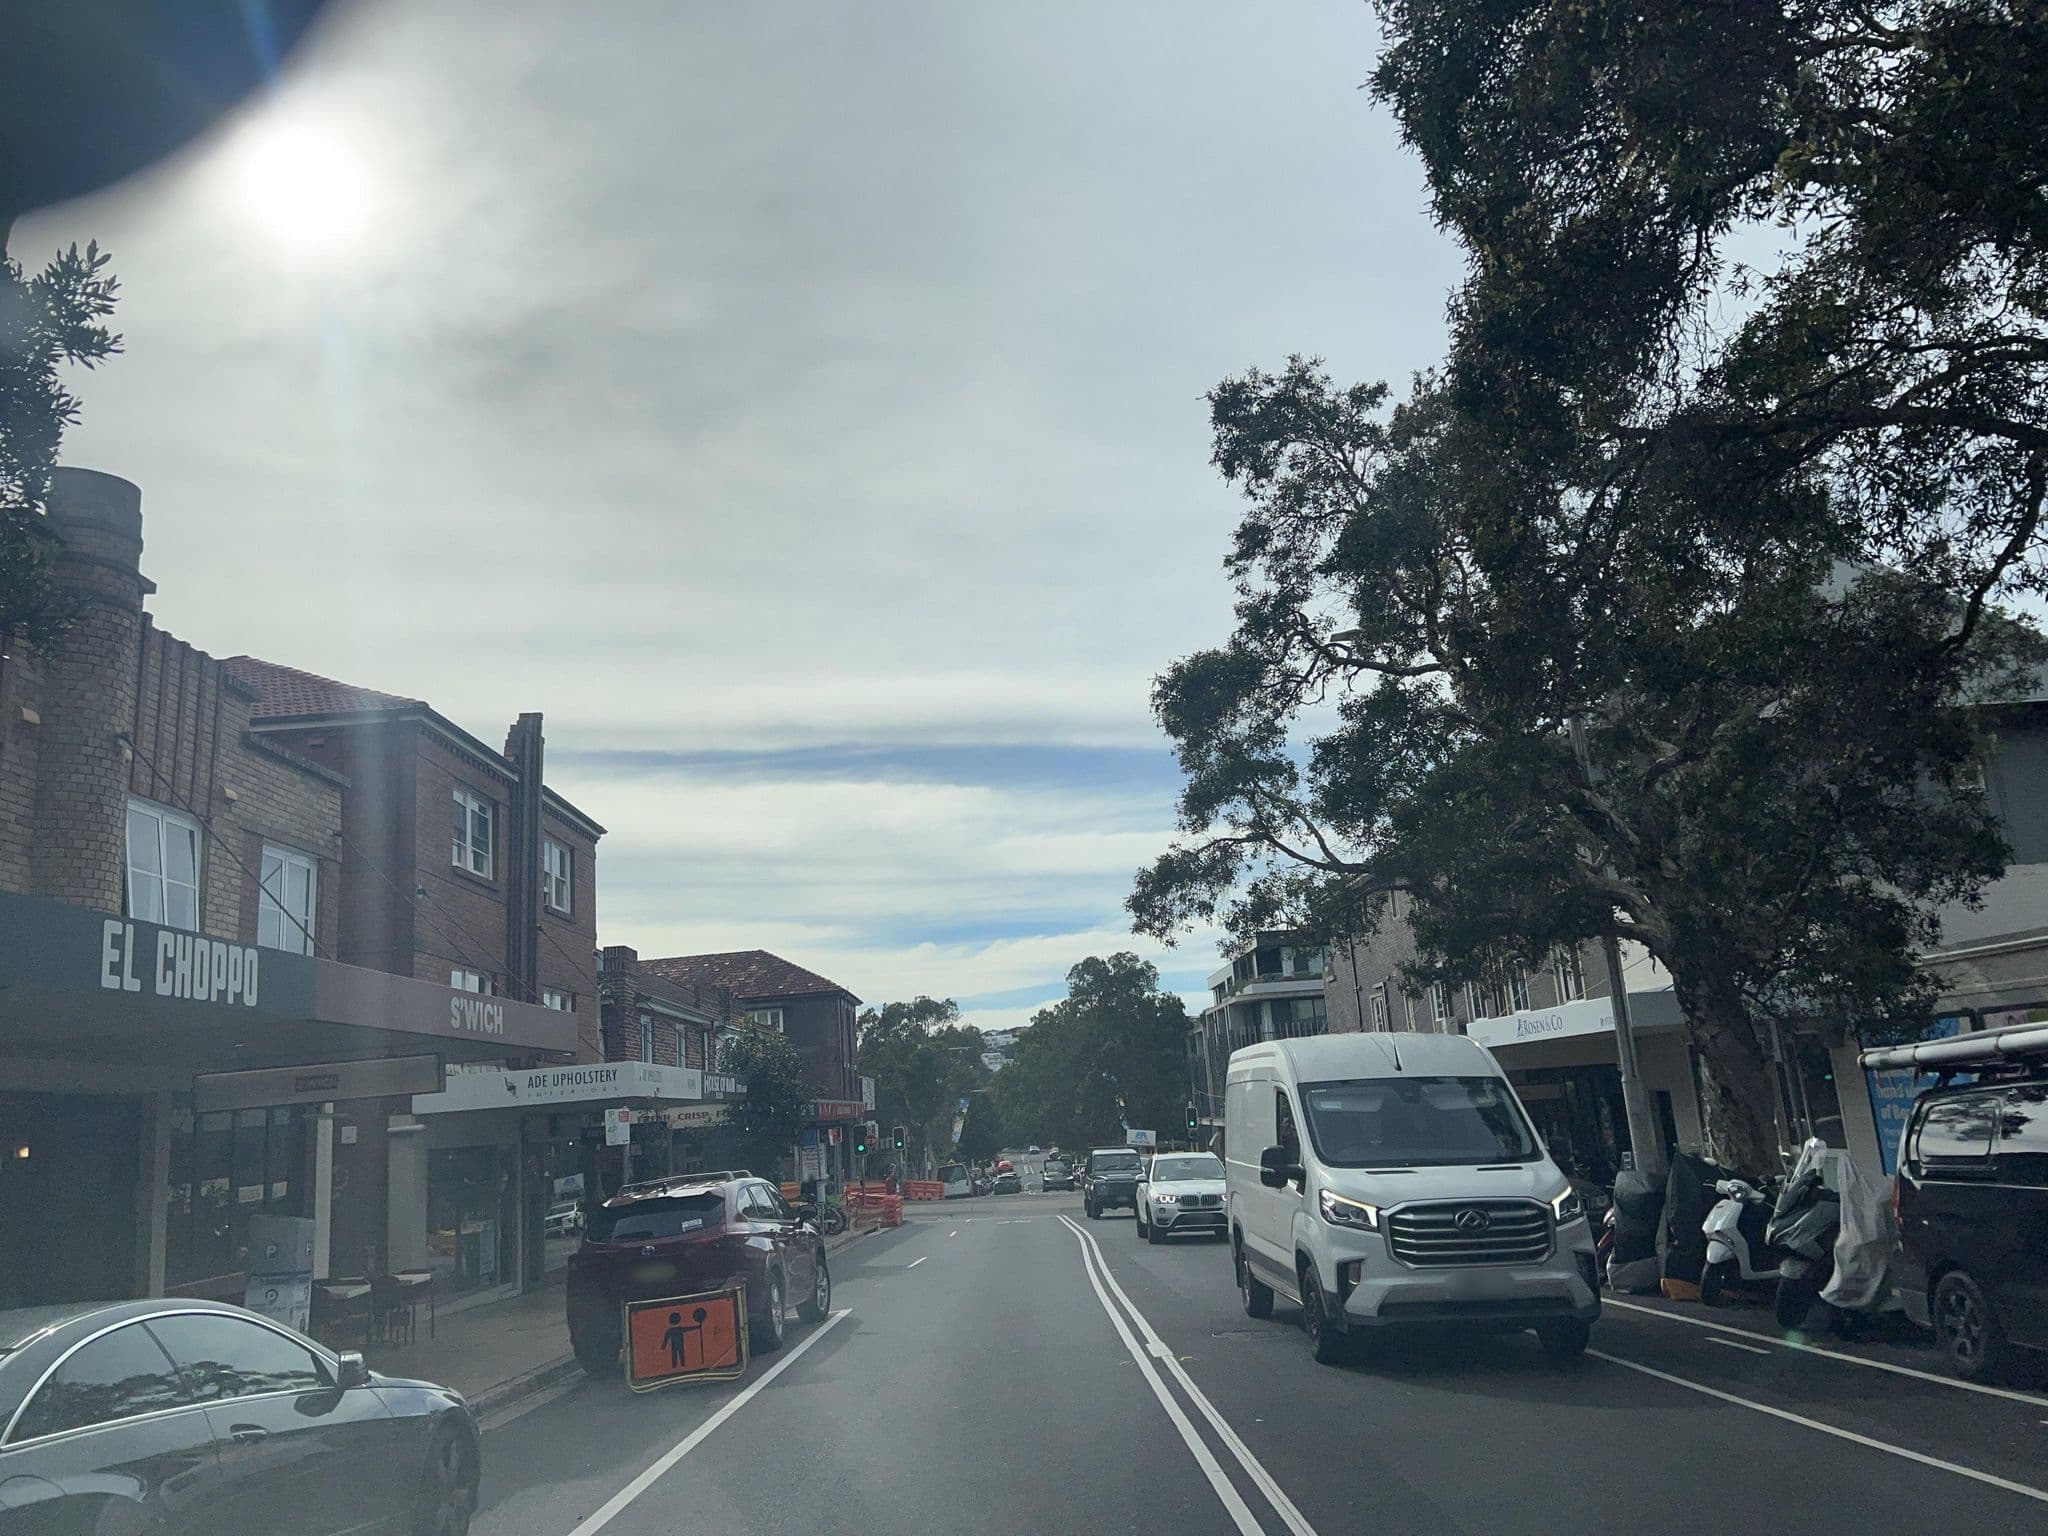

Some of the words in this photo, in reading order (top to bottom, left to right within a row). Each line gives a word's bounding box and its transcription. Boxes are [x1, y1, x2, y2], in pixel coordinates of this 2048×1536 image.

[101, 919, 141, 992] EL
[156, 930, 259, 1007] CHOPPO
[450, 996, 504, 1035] S'WICH
[528, 1074, 548, 1089] ADE
[552, 1068, 618, 1087] UPHOLSTERY
[677, 1111, 709, 1121] CRISP
